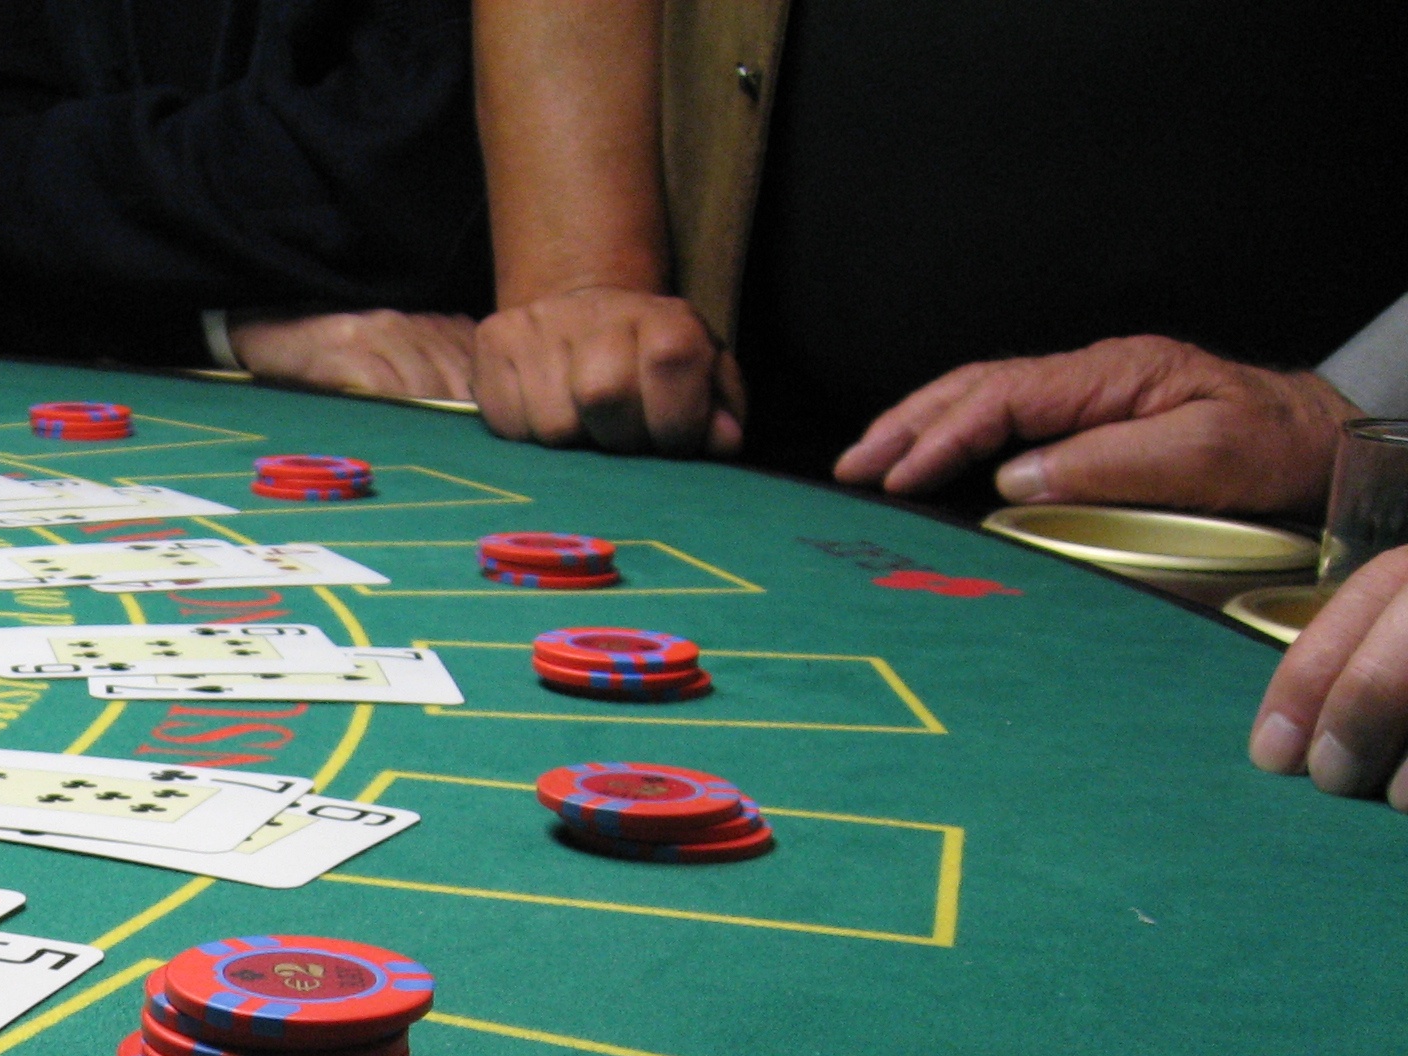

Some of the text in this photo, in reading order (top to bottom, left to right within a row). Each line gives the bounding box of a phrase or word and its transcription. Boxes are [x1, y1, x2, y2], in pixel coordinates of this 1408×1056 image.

[240, 627, 308, 637] 6
[352, 650, 423, 662] 7
[11, 663, 82, 674] 6
[105, 683, 179, 694] 7
[209, 777, 296, 795] 7
